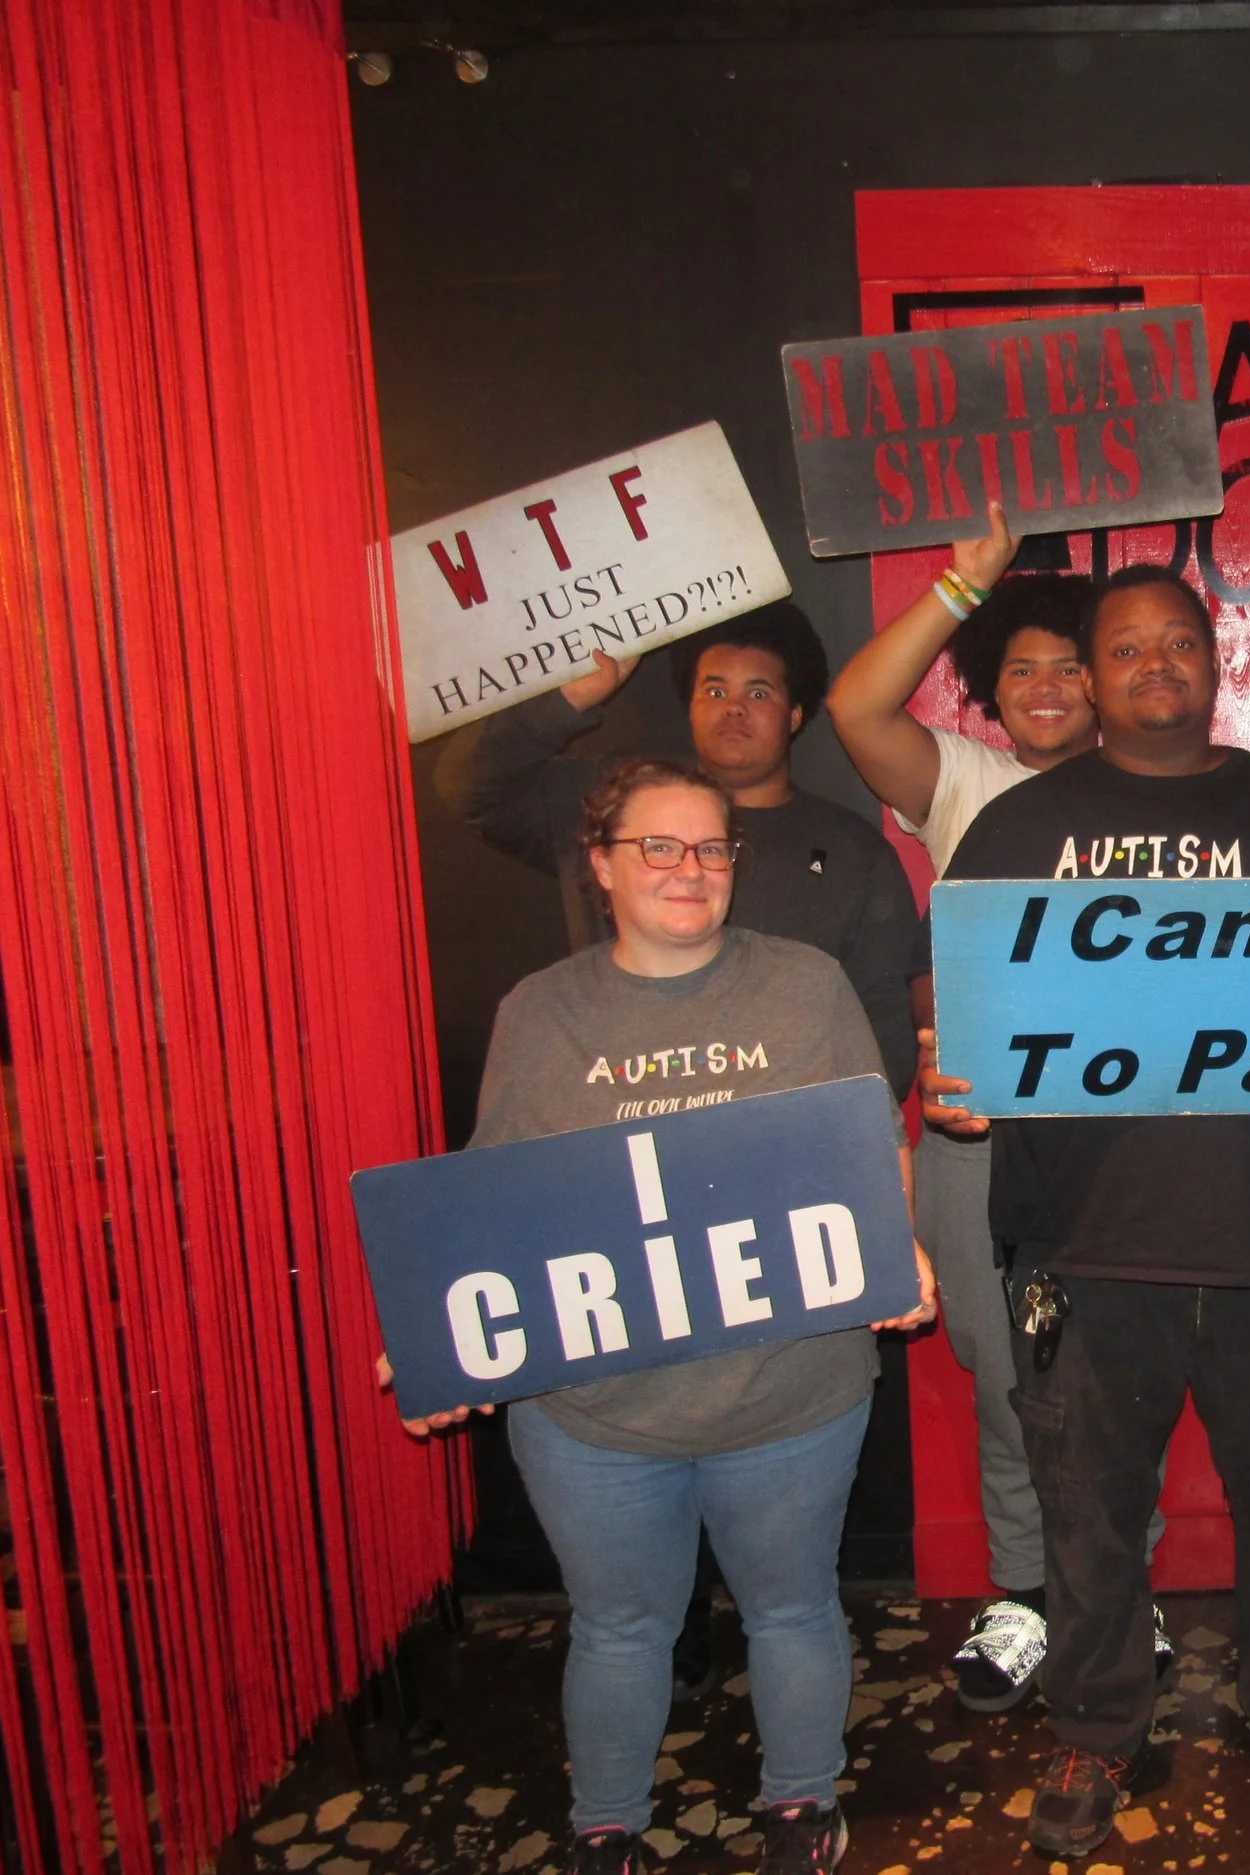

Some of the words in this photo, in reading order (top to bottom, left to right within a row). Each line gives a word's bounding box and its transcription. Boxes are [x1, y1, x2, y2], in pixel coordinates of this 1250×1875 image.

[791, 345, 957, 442] MAD
[987, 319, 1201, 420] TEAM
[873, 417, 1142, 527] SKILLS
[430, 564, 753, 716] HAPPENED?!?!
[511, 563, 629, 632] JUST
[1009, 896, 1049, 963] I
[1008, 1033, 1140, 1098] To
[626, 1131, 668, 1226] I
[446, 1203, 866, 1381] CRIED
